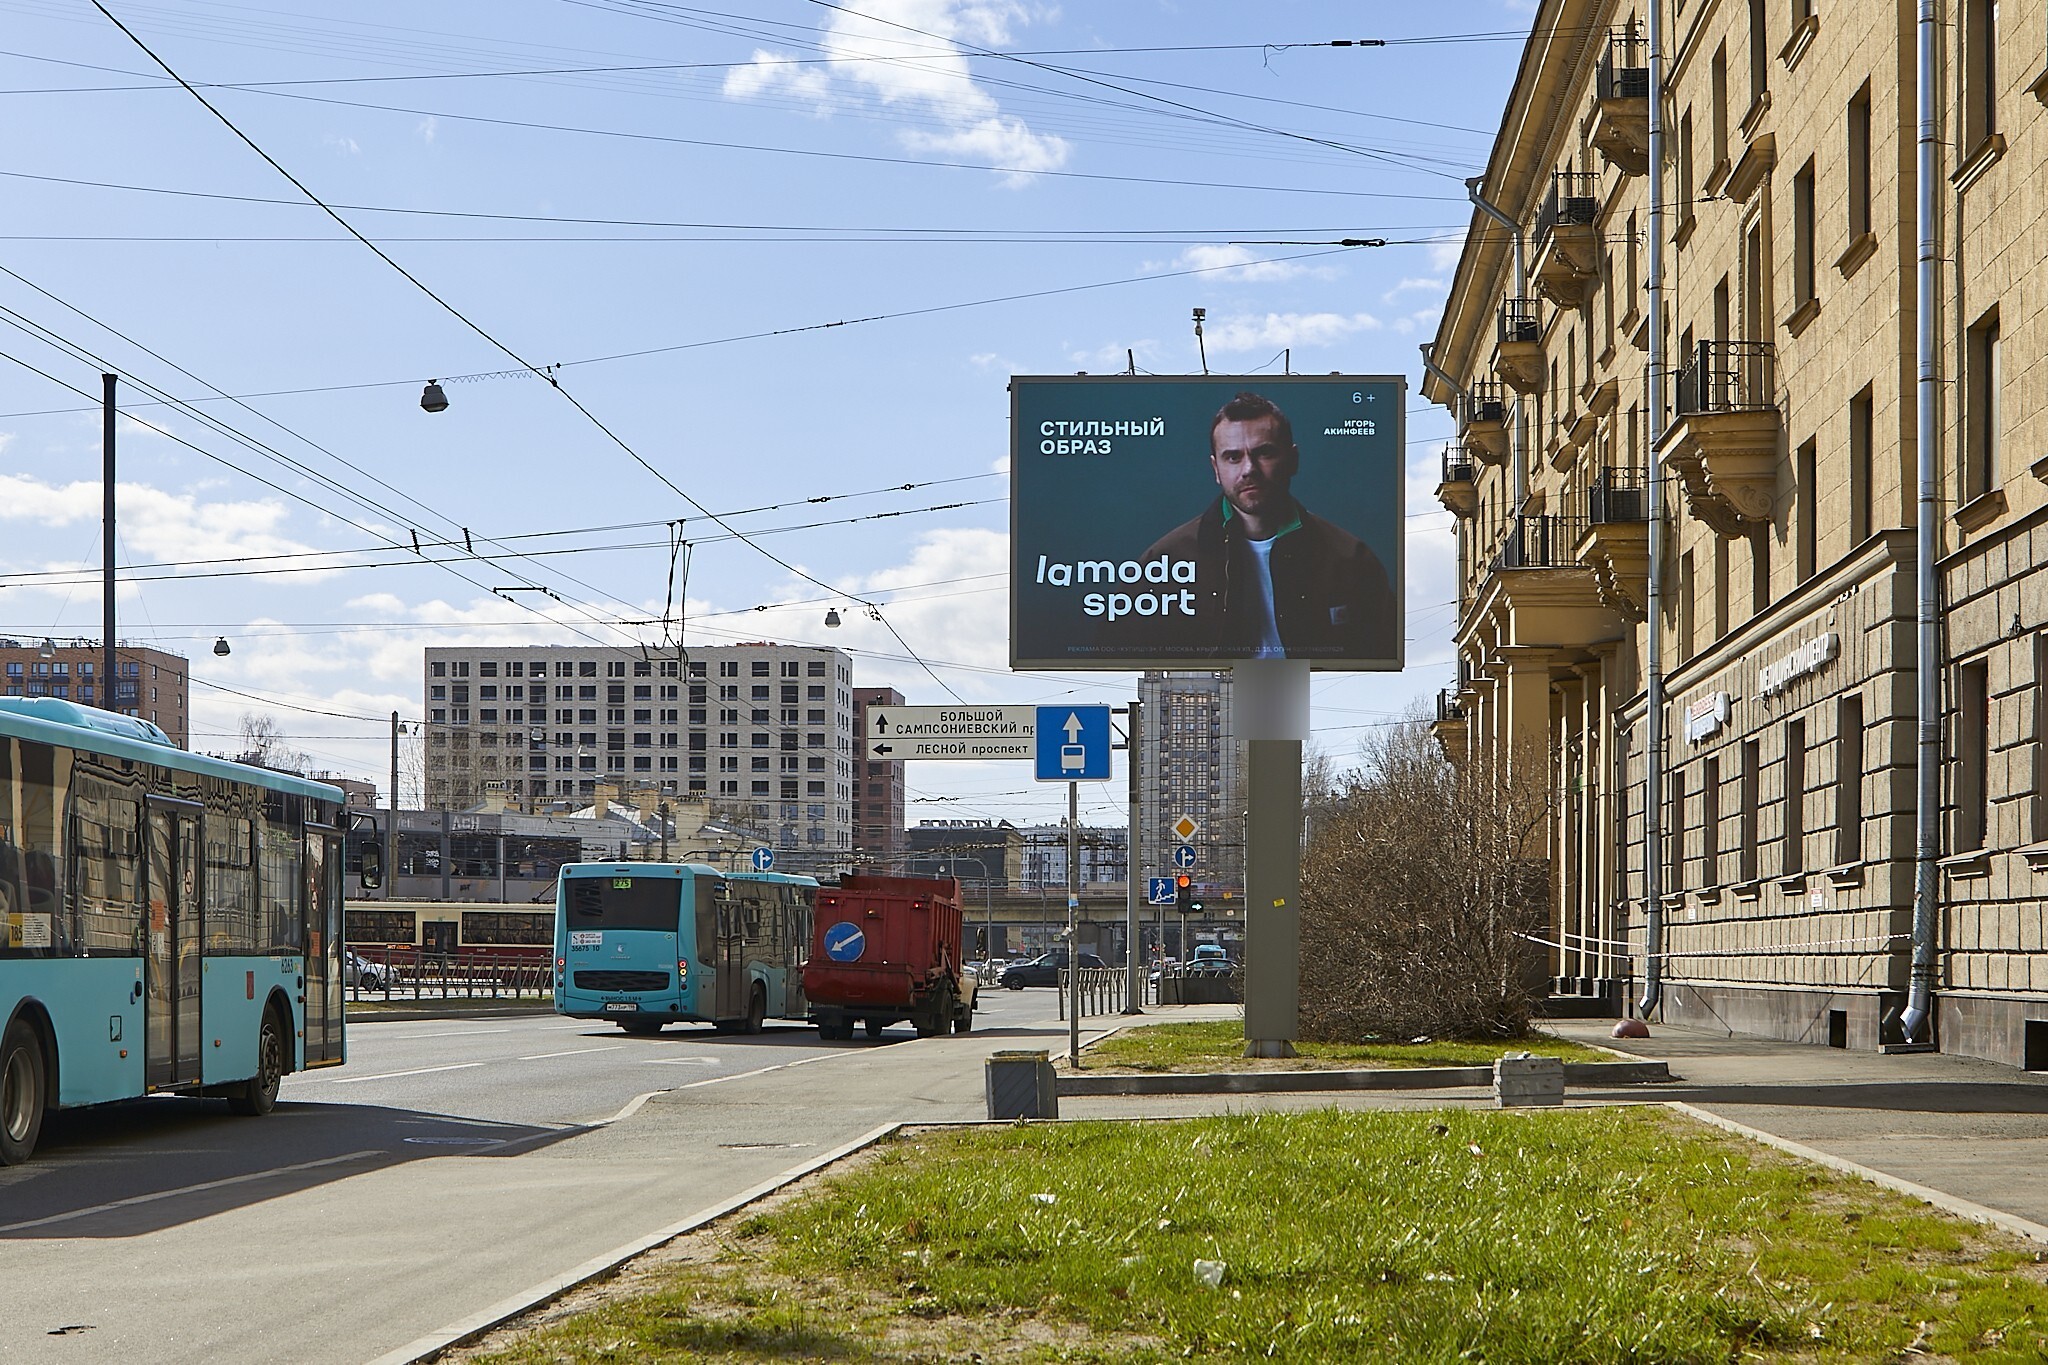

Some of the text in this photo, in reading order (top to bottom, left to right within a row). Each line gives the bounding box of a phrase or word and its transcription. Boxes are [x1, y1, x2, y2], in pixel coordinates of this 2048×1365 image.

[1040, 417, 1165, 436] СТИЛЬНЫЙ
[1344, 420, 1375, 428] ИГОРЬ
[1324, 428, 1375, 436] АКИНФЕЕВ
[1040, 440, 1112, 455] ОБРАЗ
[1036, 554, 1196, 587] lamoda
[1083, 589, 1196, 622] sport
[940, 709, 1003, 722] БОЛЬШОЙ
[896, 722, 1017, 735] САМПСОНИЕВСКИЙ
[916, 742, 1028, 755] ЛЕСНОЙ проспект
[615, 879, 629, 887] 275
[11, 925, 23, 942] 185
